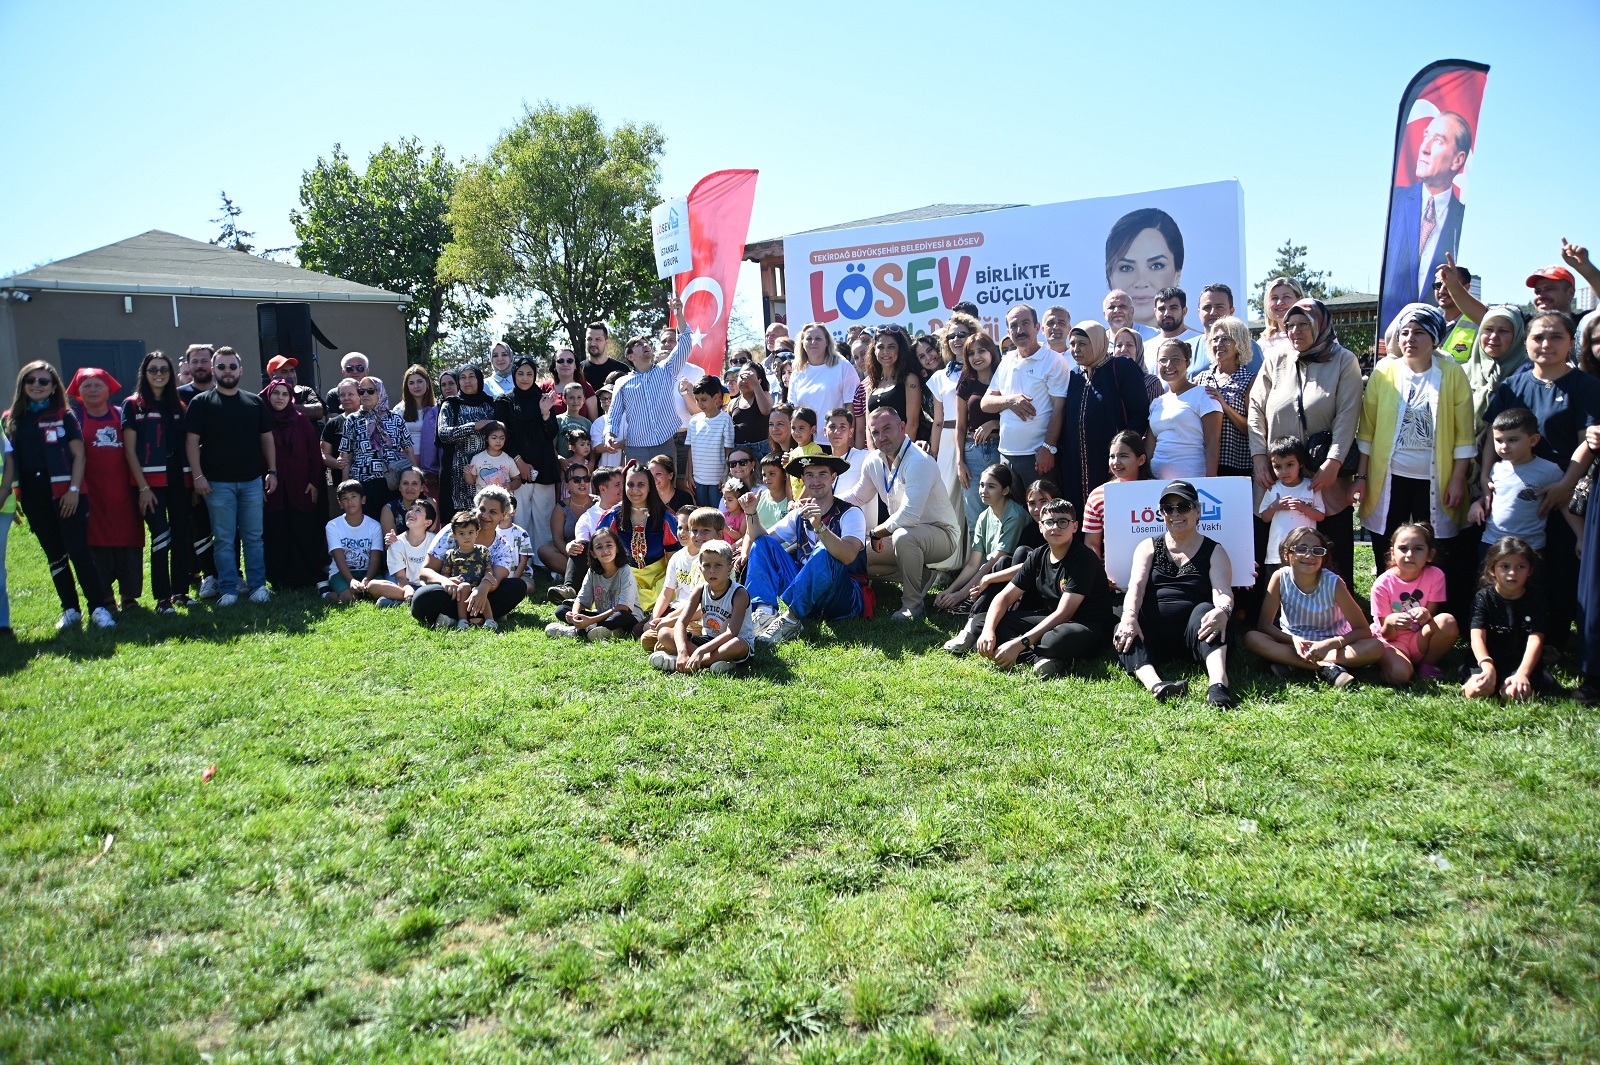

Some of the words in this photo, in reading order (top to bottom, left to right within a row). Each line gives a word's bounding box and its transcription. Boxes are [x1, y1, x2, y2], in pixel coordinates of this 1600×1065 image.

[813, 249, 851, 262] TEKİRDAĞ
[851, 245, 899, 258] BÜYÜKŞEHİR
[901, 239, 945, 253] BELEDİYESİ
[945, 239, 952, 248] &
[953, 236, 980, 247] LÖSEV
[976, 263, 1051, 284] BİRLİKTE
[809, 255, 972, 323] LÖSEV
[976, 280, 1071, 305] GÜÇLÜYÜZ
[1131, 507, 1164, 523] LÖS
[1131, 523, 1164, 533] Lösemili
[1202, 523, 1222, 531] Vakfı
